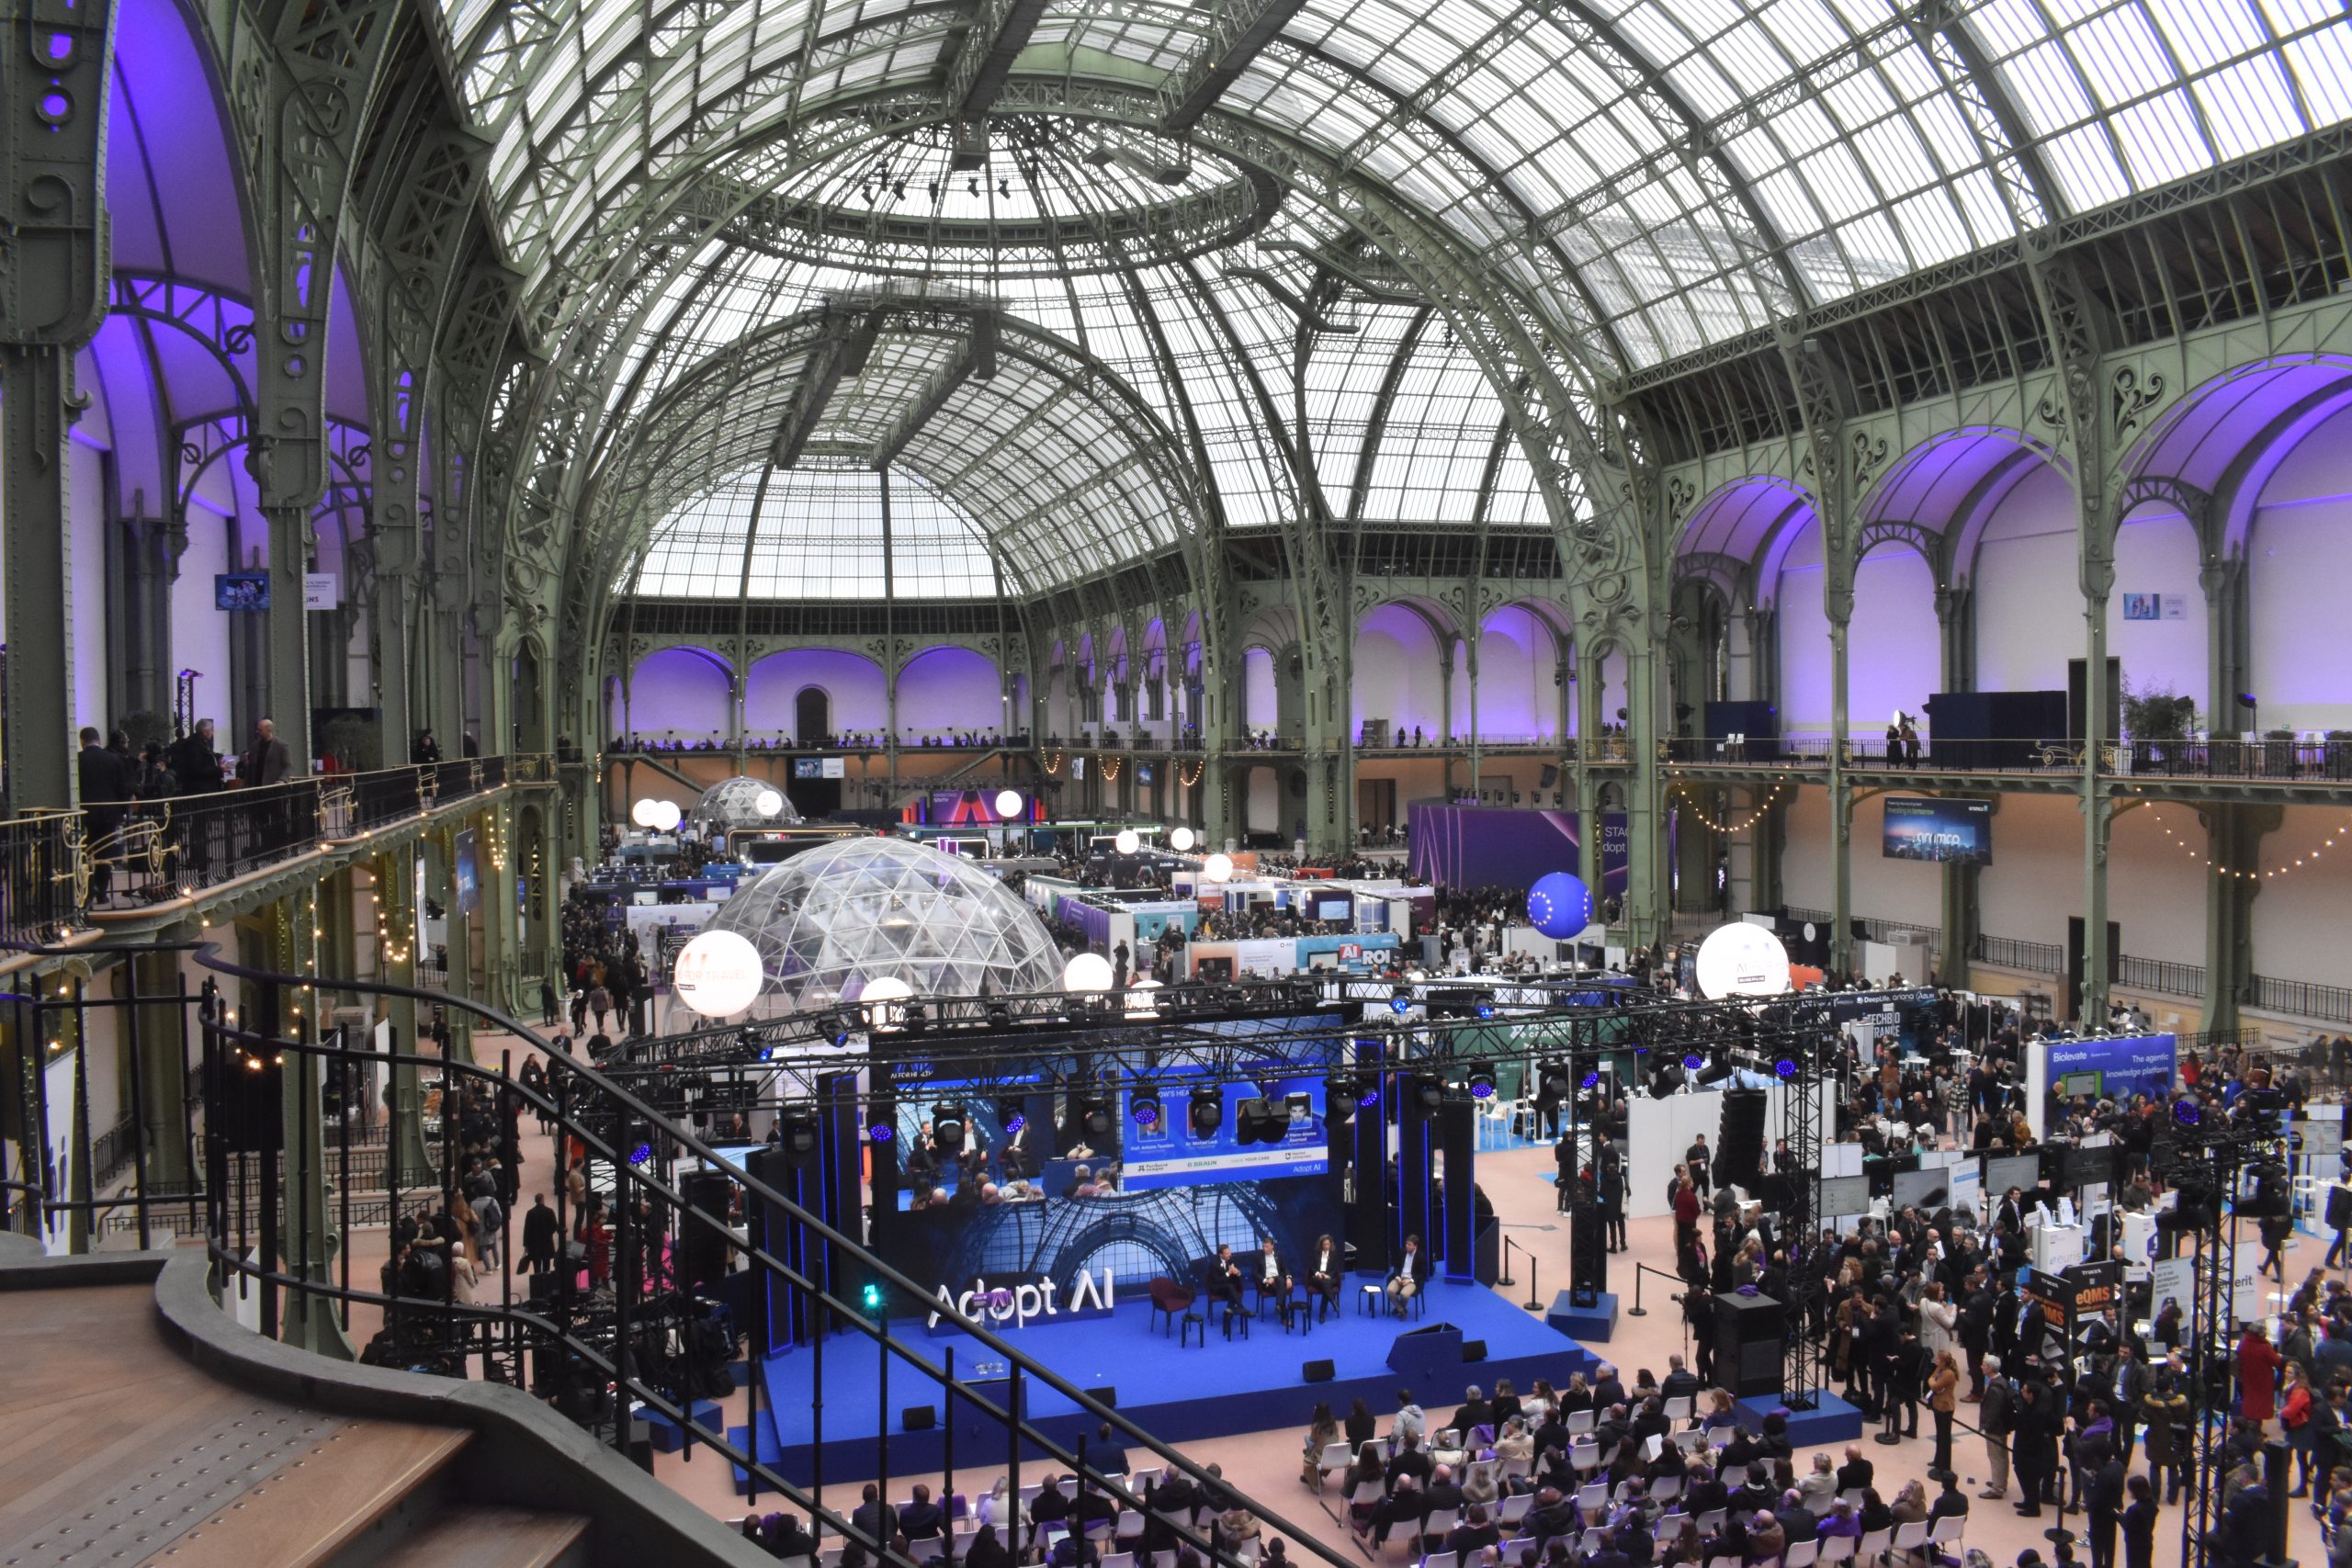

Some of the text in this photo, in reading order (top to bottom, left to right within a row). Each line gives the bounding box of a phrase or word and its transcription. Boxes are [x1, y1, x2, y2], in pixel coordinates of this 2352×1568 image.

[1602, 840, 1626, 854] dopt
[1341, 945, 1358, 958] AI
[1363, 949, 1390, 965] ROI
[1867, 1011, 1901, 1025] TECHBO
[1874, 1024, 1901, 1039] RANCE
[2052, 1051, 2087, 1063] Biolevate
[2132, 1053, 2168, 1064] The agentic
[2106, 1066, 2169, 1077] knowledge platform
[1293, 1163, 1321, 1173] Adopt AI
[928, 1267, 1114, 1329] Adopt AI
[2075, 1286, 2110, 1305] eQMS
